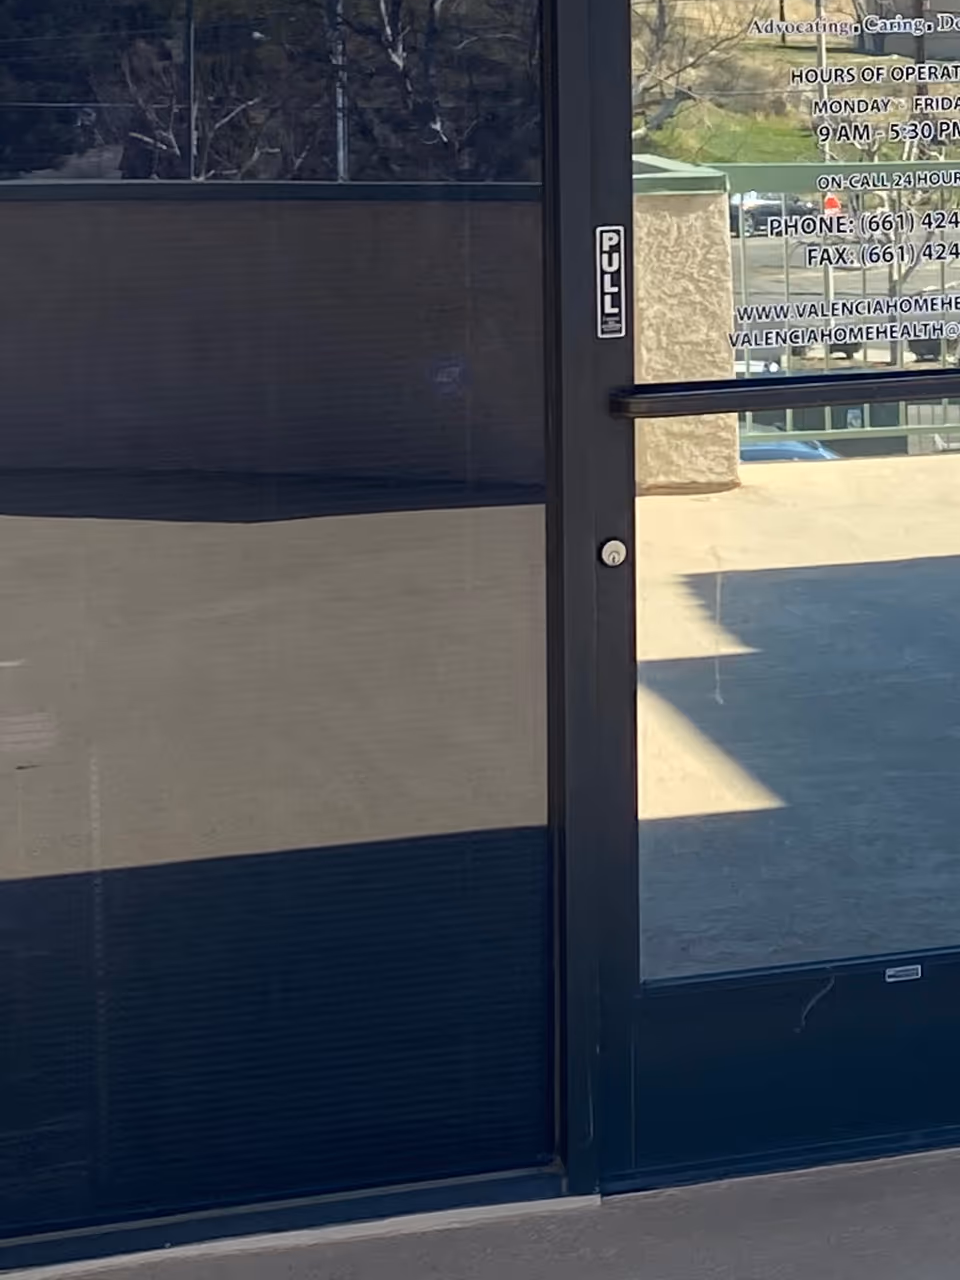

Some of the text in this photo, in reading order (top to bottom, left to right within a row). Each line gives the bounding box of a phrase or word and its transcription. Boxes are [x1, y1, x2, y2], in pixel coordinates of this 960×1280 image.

[790, 66, 856, 84] HOURS
[861, 65, 886, 83] OF
[813, 99, 892, 115] MONDAY
[819, 125, 830, 143] 9
[837, 124, 871, 141] AM
[889, 123, 933, 140] 5:30
[817, 173, 889, 191] ON-CALL
[892, 172, 912, 188] 24
[768, 216, 854, 236] PHONE:
[861, 211, 914, 234] (661)
[807, 246, 855, 266] FAX:
[861, 243, 915, 265] (661)
[602, 231, 620, 314] PULL
